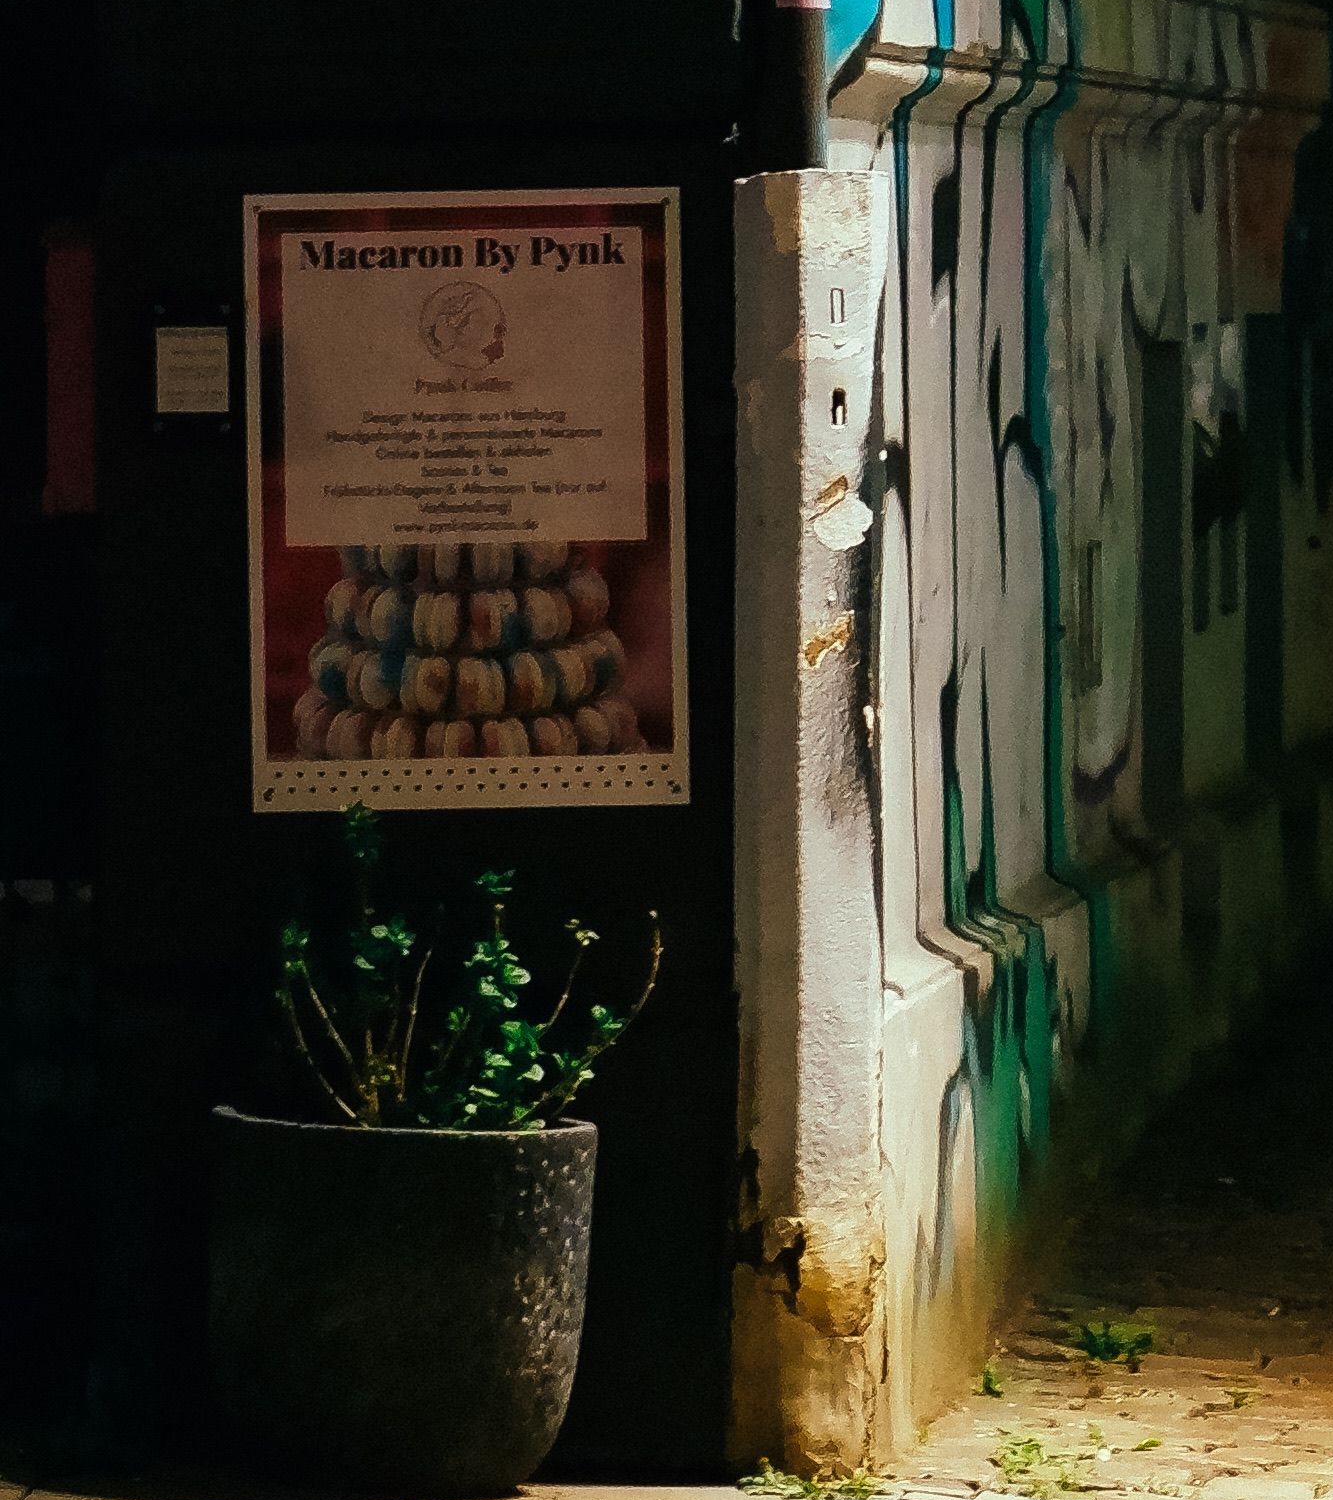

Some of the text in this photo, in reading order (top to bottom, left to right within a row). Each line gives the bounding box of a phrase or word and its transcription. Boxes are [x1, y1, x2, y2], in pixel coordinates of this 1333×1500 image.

[299, 232, 626, 273] Macaron By Pynk
